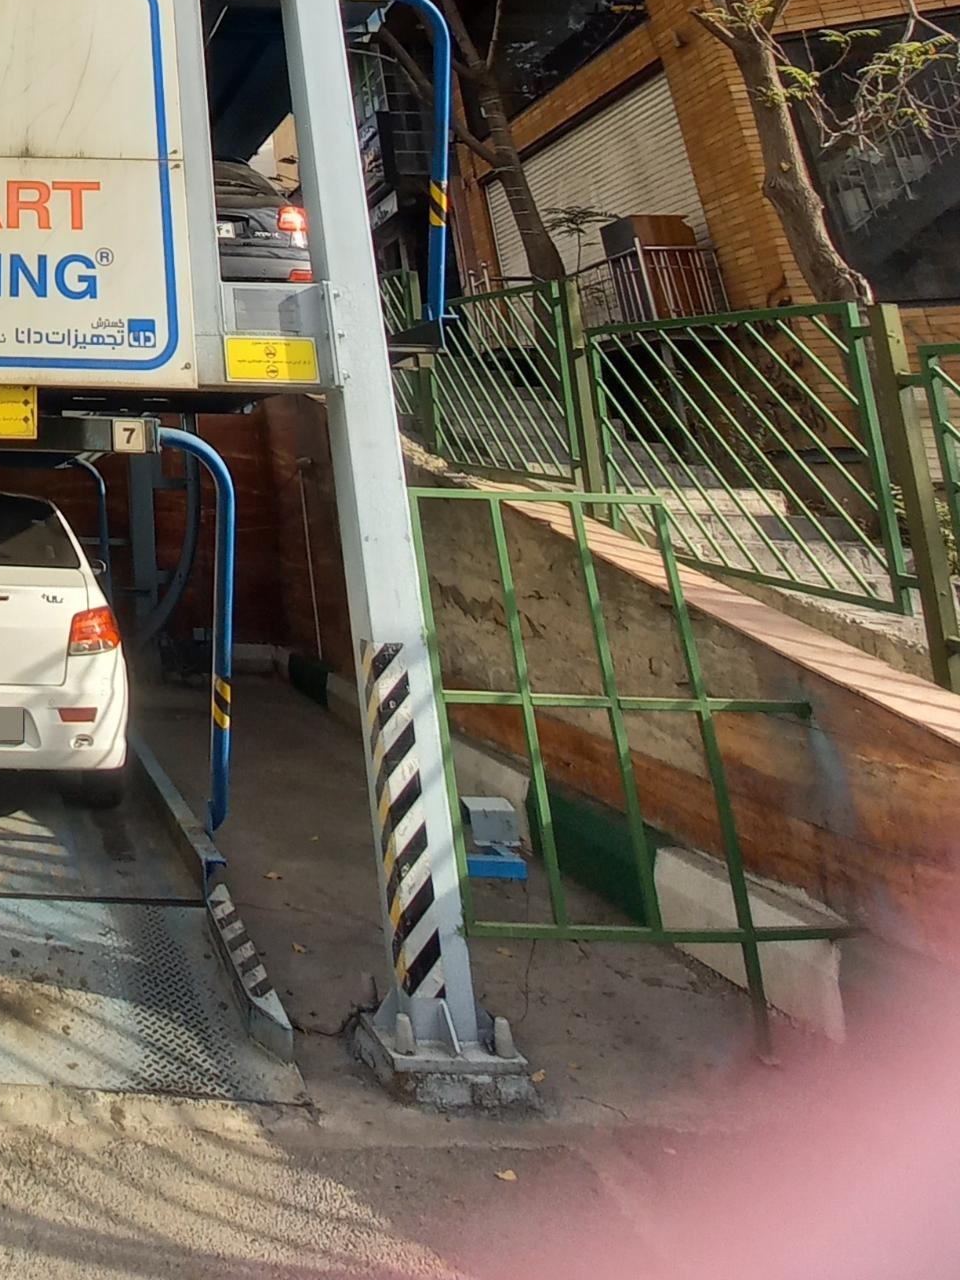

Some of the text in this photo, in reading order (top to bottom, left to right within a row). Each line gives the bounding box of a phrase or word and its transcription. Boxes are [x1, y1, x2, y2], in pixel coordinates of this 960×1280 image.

[90, 317, 125, 329] گسترش
[15, 327, 43, 345] دانا
[46, 329, 125, 350] تجهیزات
[122, 427, 136, 444] 7
